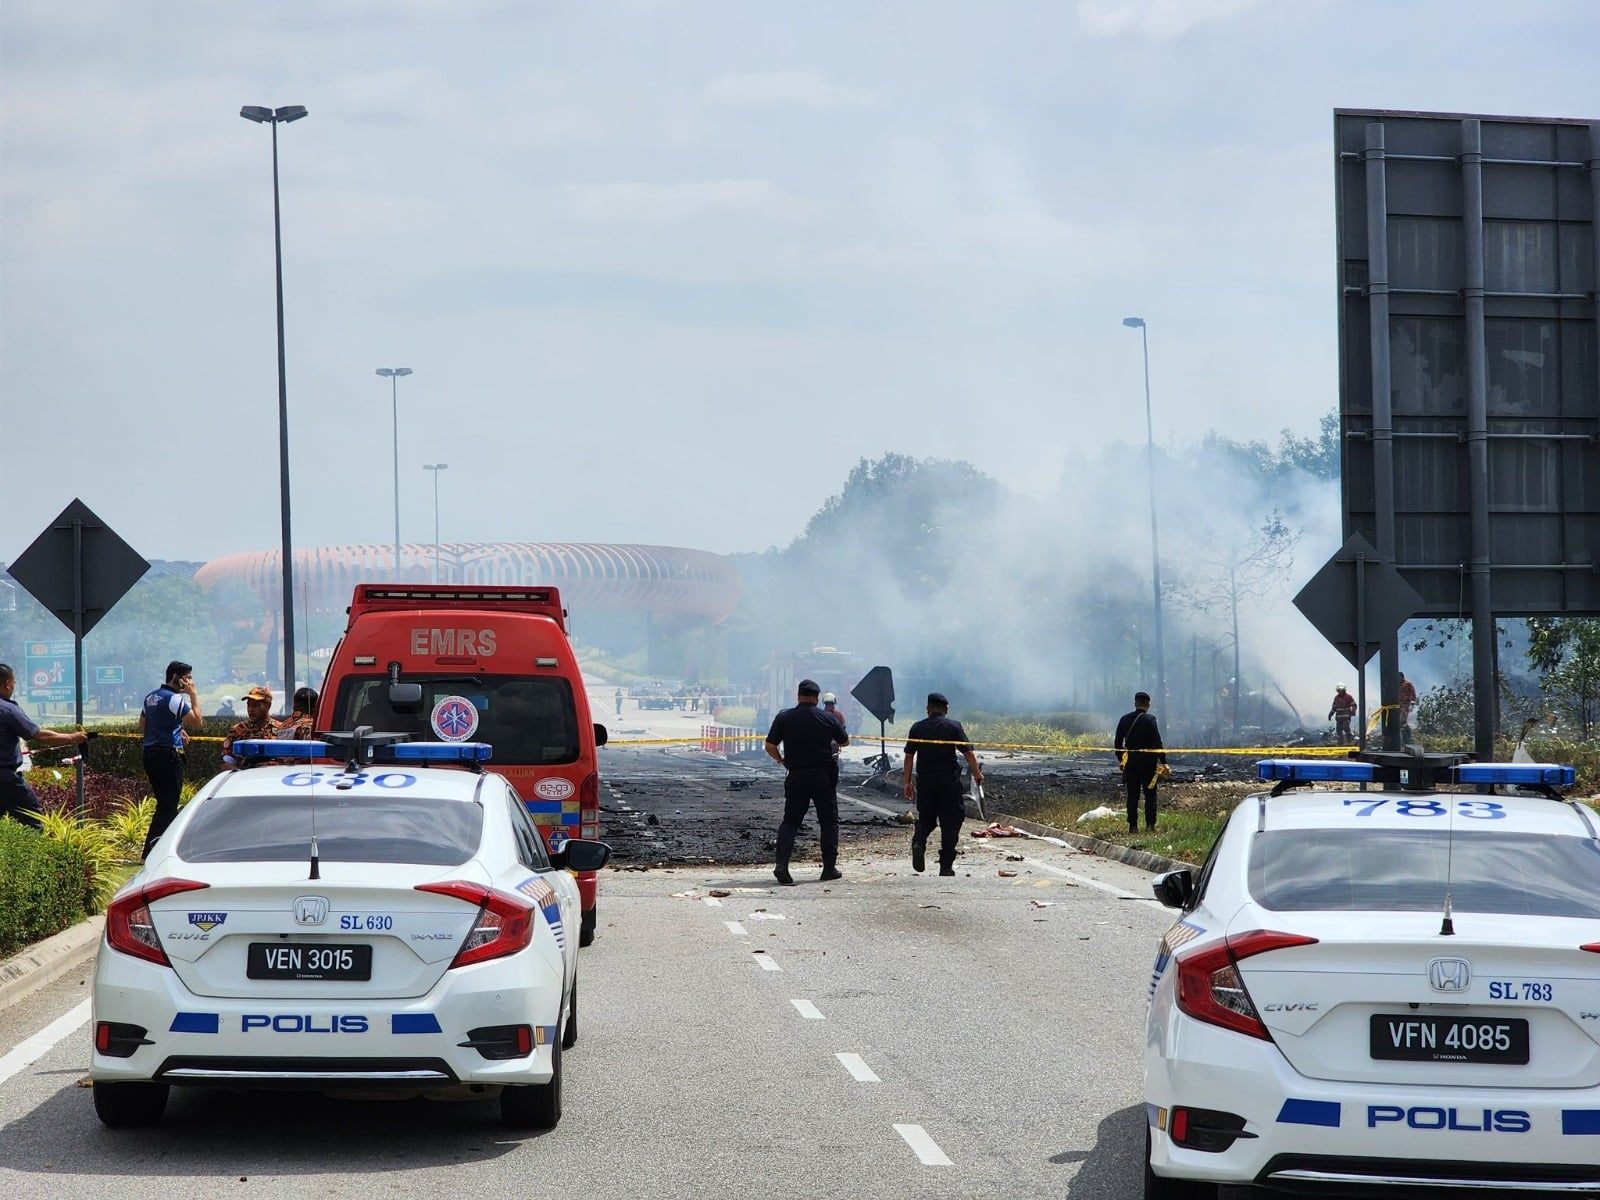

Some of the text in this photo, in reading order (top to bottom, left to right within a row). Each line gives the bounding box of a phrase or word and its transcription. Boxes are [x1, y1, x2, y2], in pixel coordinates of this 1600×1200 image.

[411, 628, 497, 656] EMRS
[281, 772, 417, 789] 630
[1343, 799, 1507, 820] 783
[191, 913, 222, 922] JPJKK
[340, 915, 392, 931] SL 630
[168, 932, 211, 941] CIVIC
[265, 948, 354, 970] VEN 3015
[1489, 981, 1552, 1002] SL 783
[1264, 1002, 1320, 1012] CIVIC
[242, 1014, 369, 1033] POLIS
[1388, 1021, 1511, 1051] VFN 4085
[1367, 1105, 1531, 1133] POLIS
